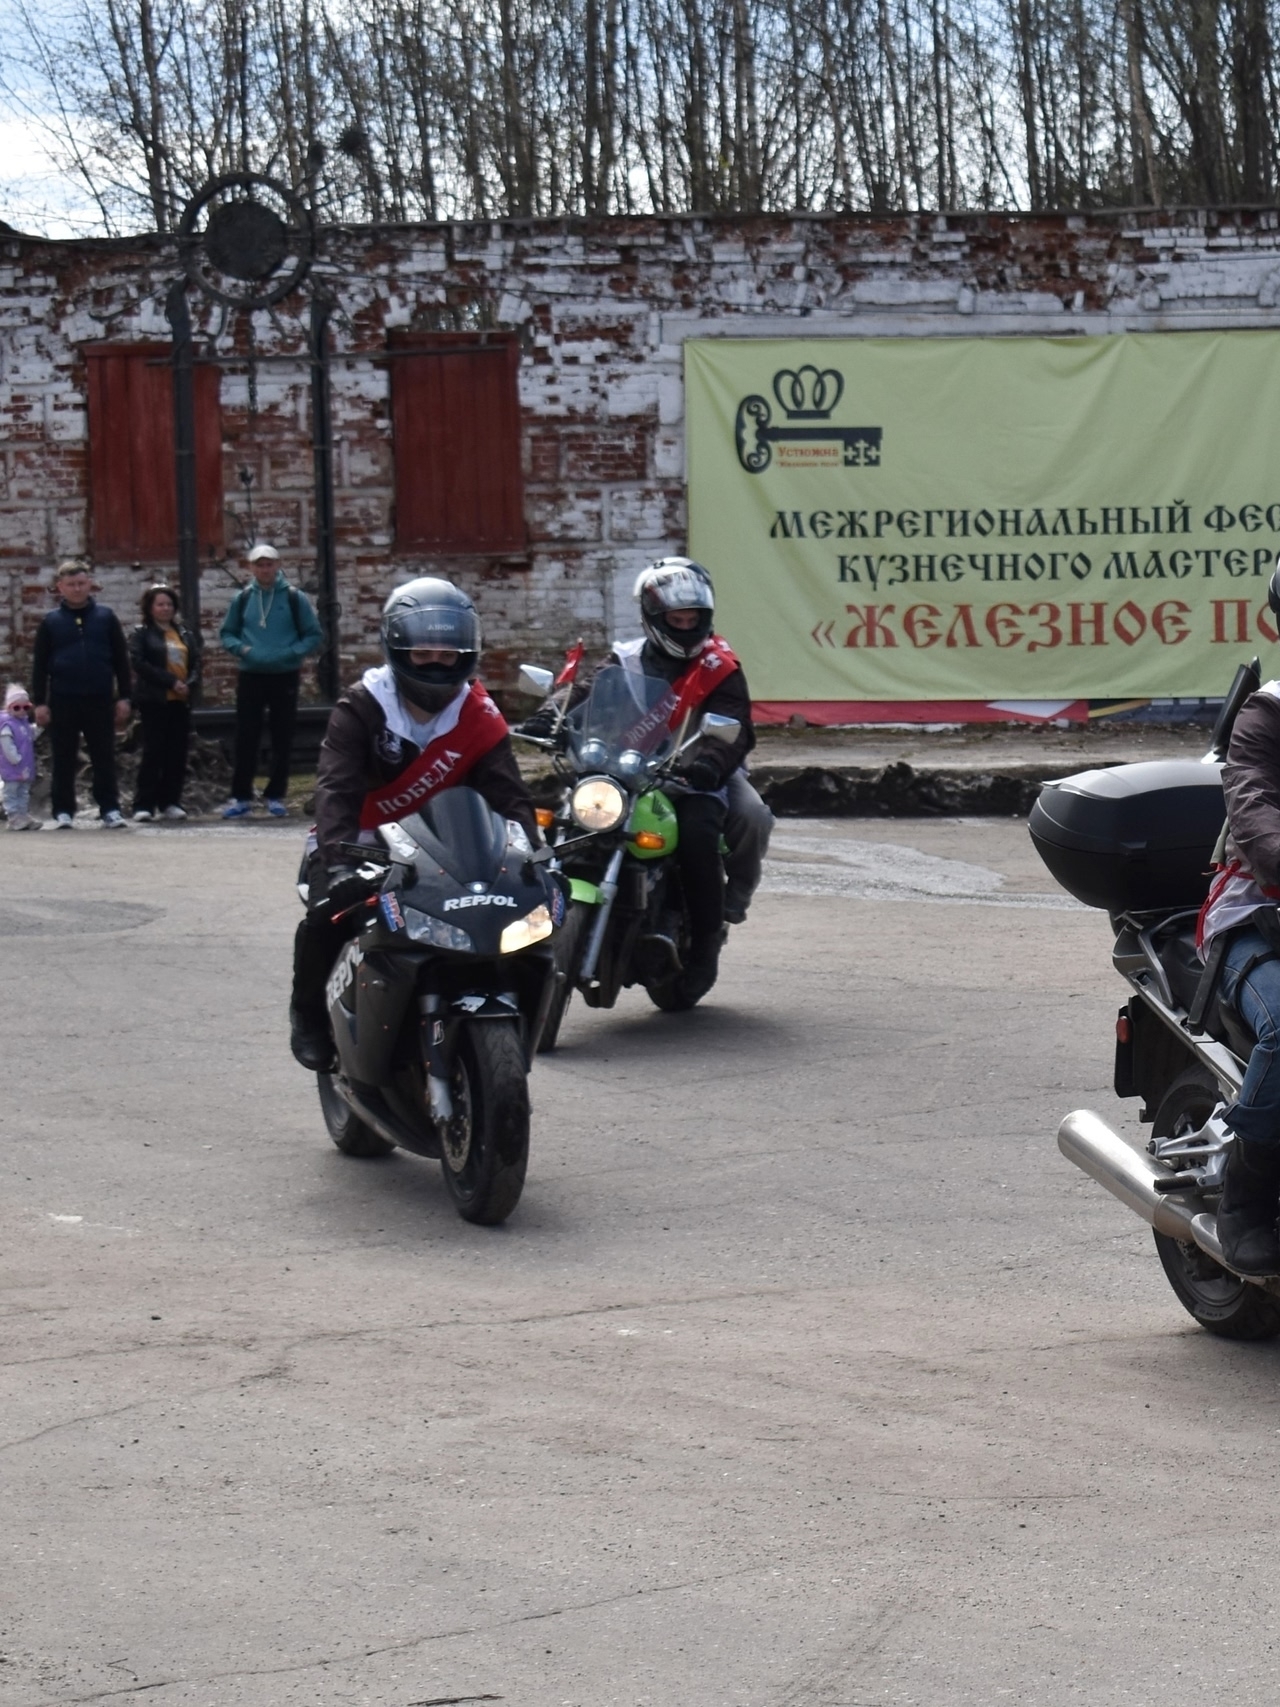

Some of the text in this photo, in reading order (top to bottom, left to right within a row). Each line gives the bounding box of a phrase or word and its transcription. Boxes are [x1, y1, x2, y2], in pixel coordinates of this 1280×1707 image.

[769, 499, 1192, 539] МЕЖРЕГИОНАЛЬНЫЙ
[837, 551, 1092, 592] КУЗНЕЧНОГО
[376, 749, 463, 815] ПОБЕДА
[443, 894, 518, 911] REPSOL
